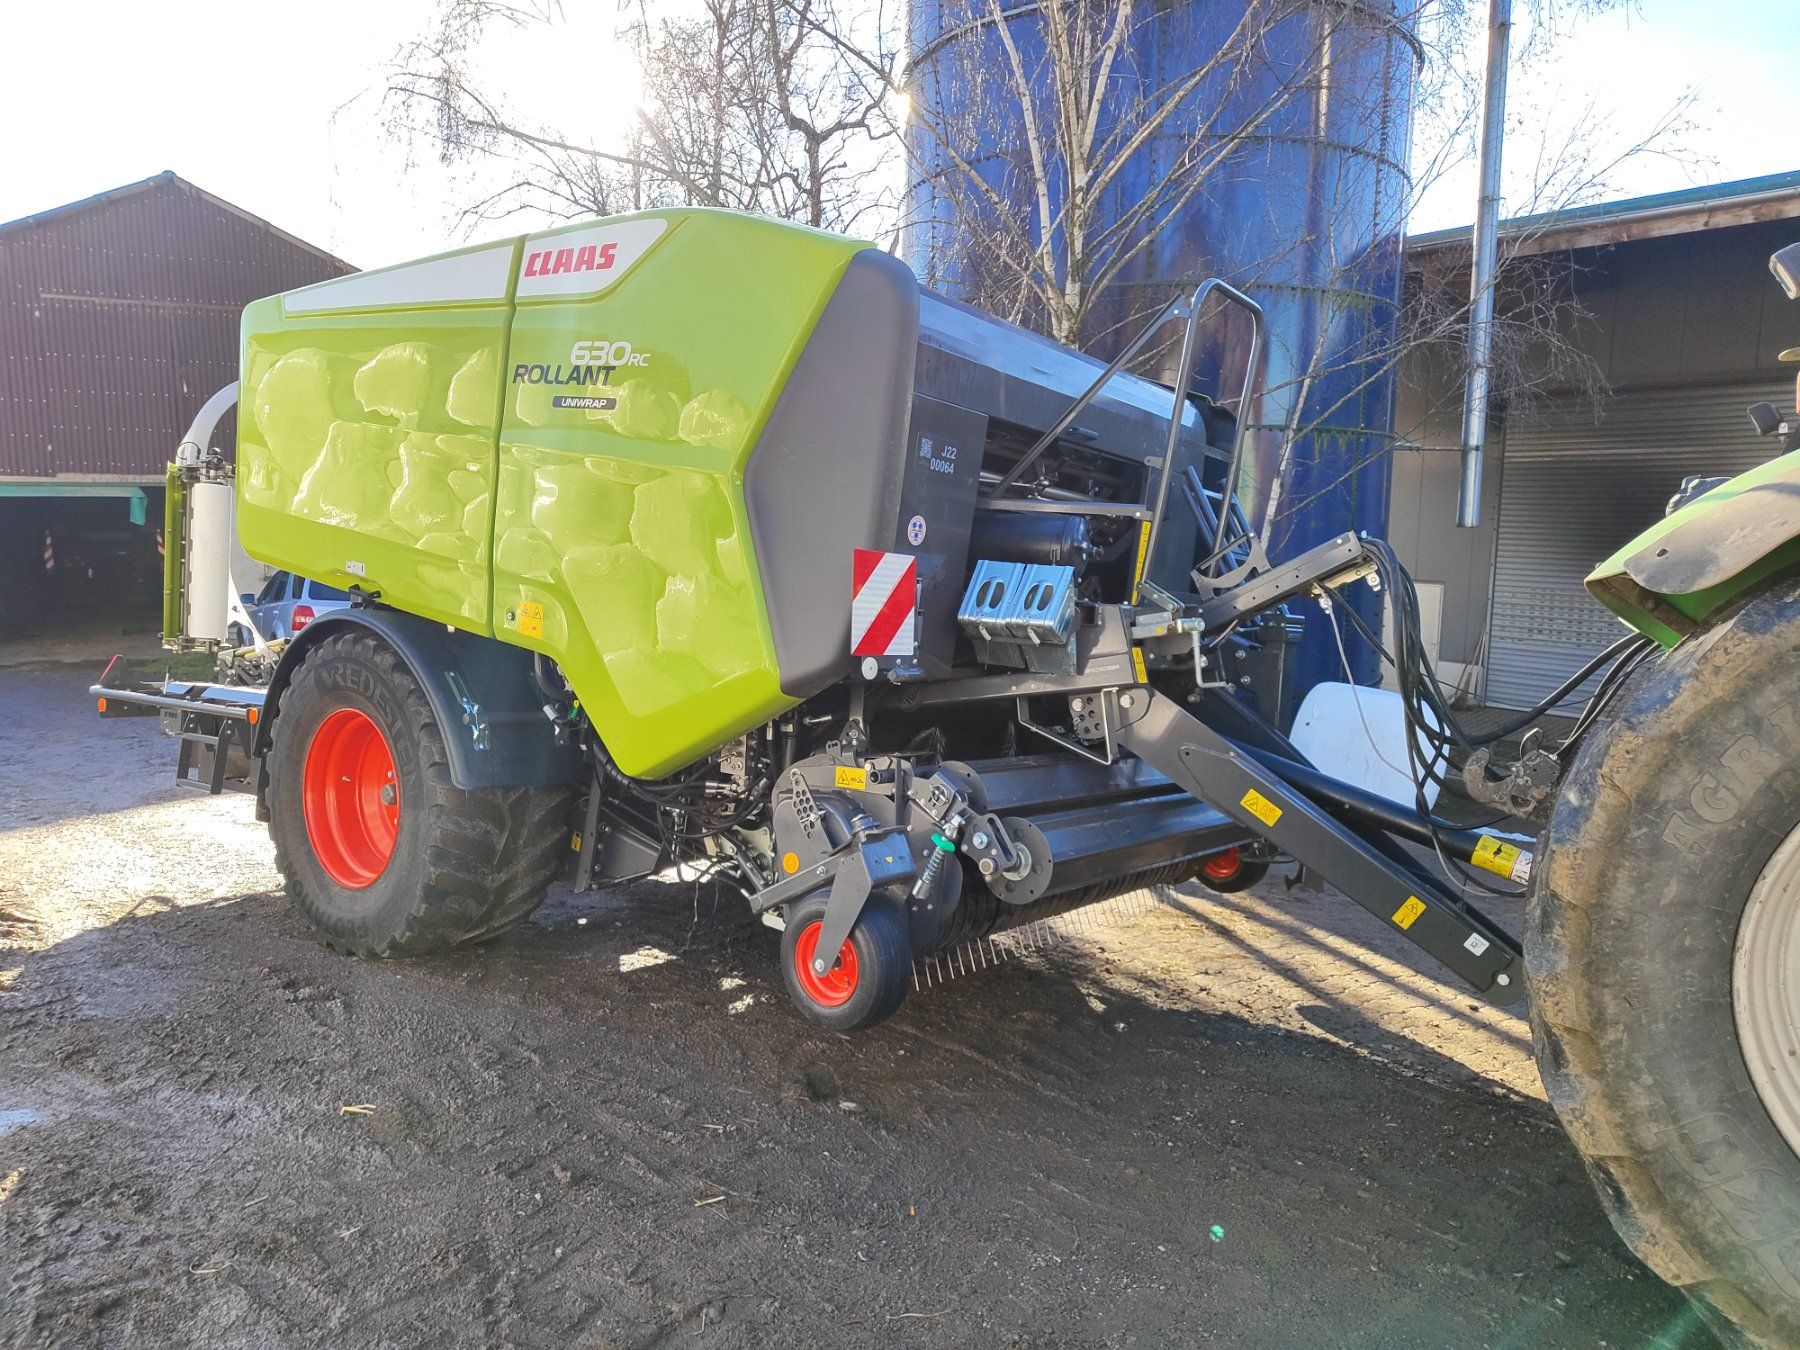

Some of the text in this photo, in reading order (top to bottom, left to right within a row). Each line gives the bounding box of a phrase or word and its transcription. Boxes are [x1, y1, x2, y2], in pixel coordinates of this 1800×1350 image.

[524, 243, 618, 277] CLAAS
[512, 364, 616, 387] ROLLANT
[561, 398, 607, 409] UNIWRAP
[941, 445, 957, 460] J22
[930, 458, 955, 475] 00064
